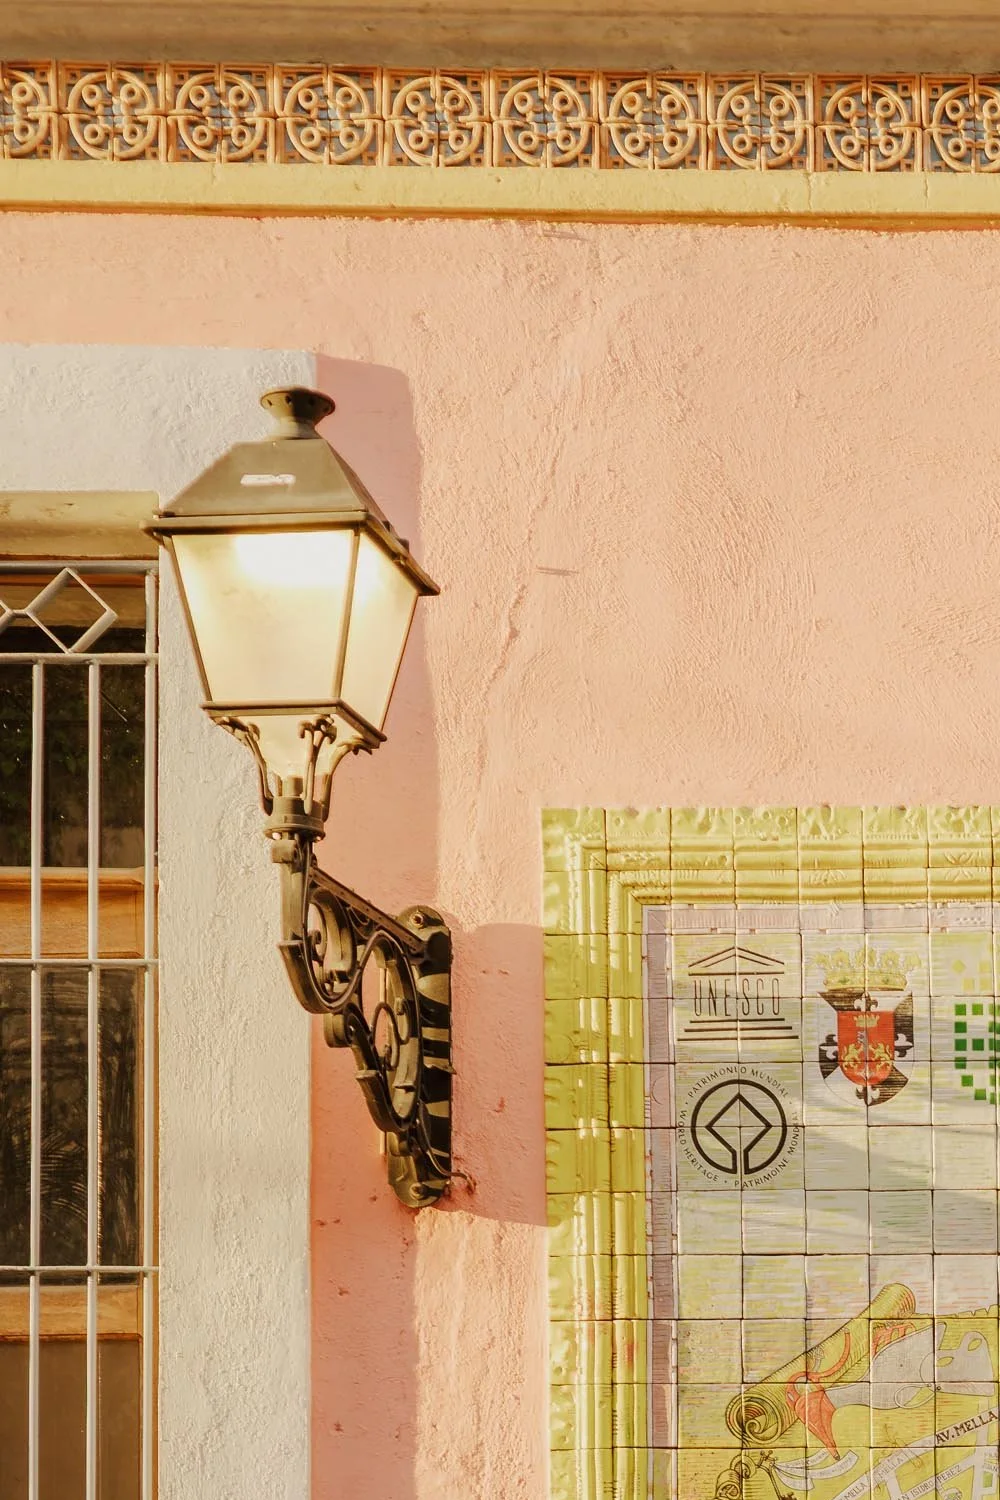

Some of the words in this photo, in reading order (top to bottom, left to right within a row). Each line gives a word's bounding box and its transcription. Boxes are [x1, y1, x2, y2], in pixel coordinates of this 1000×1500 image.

[693, 977, 780, 1017] UNESCO
[687, 1066, 747, 1098] PATRIMONIO
[751, 1069, 789, 1098] MUNDIAL
[677, 1109, 688, 1145] WORLD
[684, 1148, 719, 1182] HERITAGE
[734, 1157, 789, 1188] PATRIMOINE
[955, 1410, 999, 1437] MELLA
[911, 1481, 934, 1498] ISIDRO
